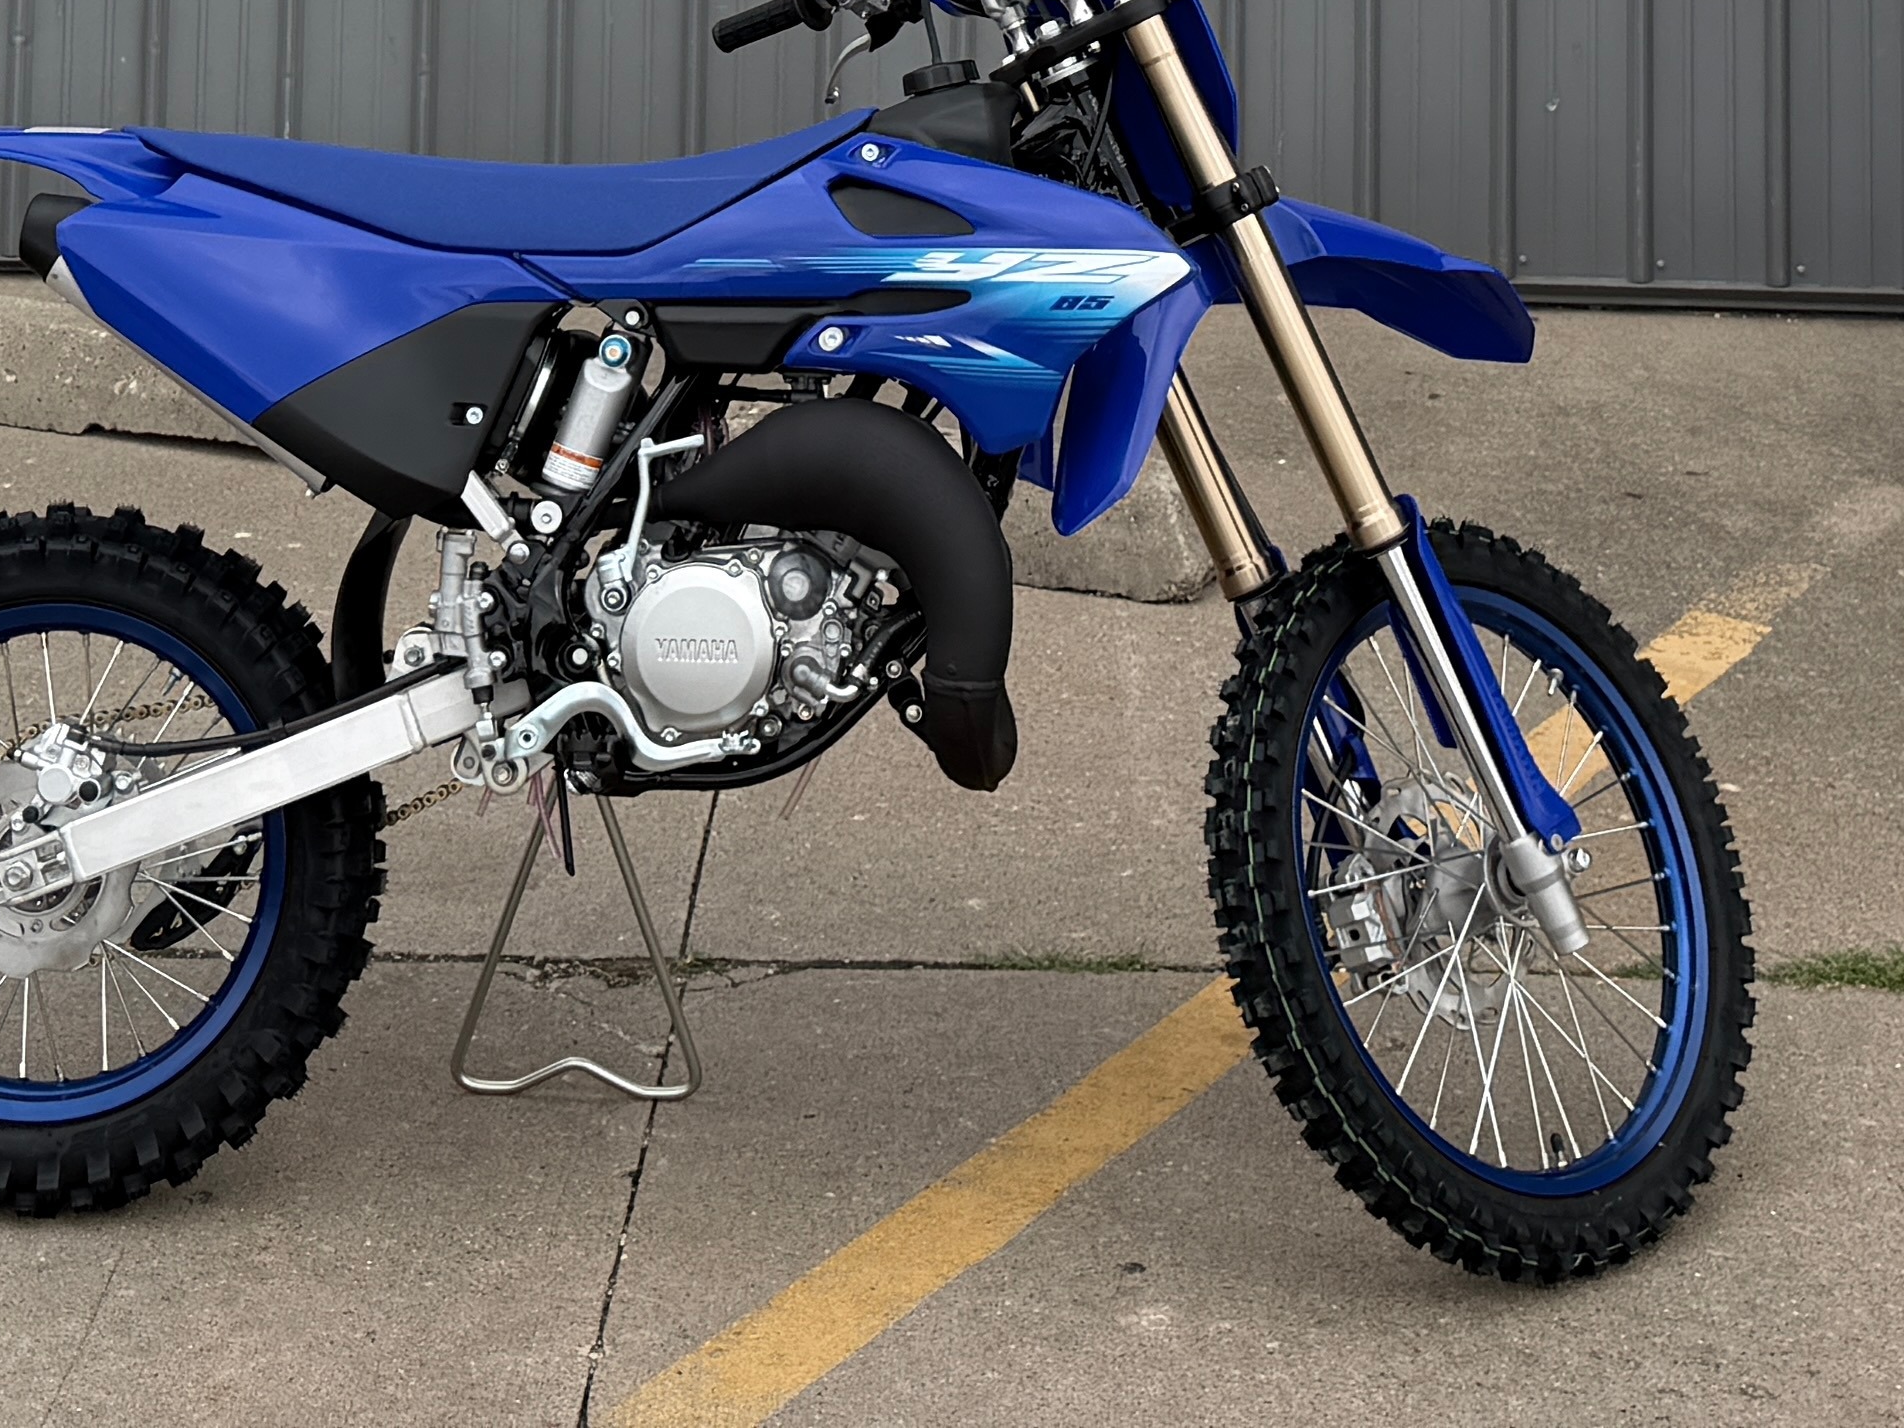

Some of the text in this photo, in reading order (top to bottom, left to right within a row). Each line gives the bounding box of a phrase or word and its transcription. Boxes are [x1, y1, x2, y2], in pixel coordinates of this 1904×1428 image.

[880, 250, 1160, 284] YZ
[1049, 295, 1115, 312] 85
[655, 637, 738, 663] YAMAHA
